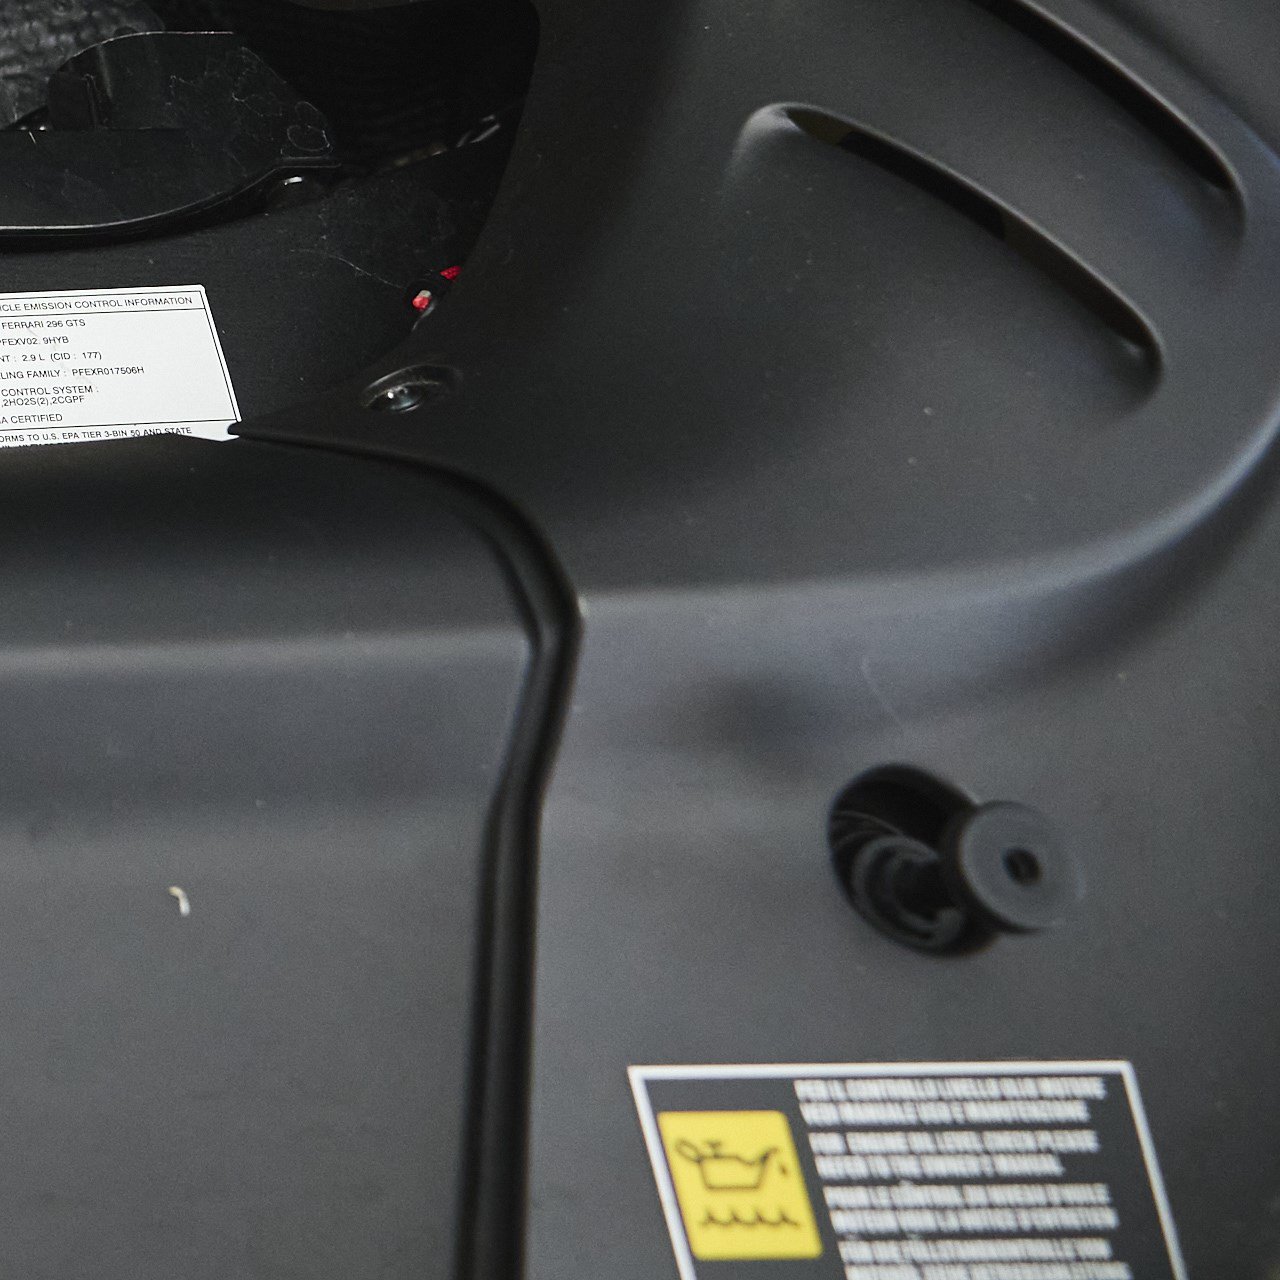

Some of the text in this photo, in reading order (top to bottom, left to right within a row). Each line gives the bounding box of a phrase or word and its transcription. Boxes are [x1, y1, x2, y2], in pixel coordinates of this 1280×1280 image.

[24, 301, 72, 311] EMISSION
[74, 300, 123, 309] CONTROL
[124, 296, 193, 306] INFORMATION
[2, 320, 44, 330] FERRARI
[46, 320, 64, 328] 296
[66, 319, 86, 328] GTS
[21, 354, 37, 362] 2.9
[82, 351, 102, 360] 177)
[1, 387, 51, 396] CONTROL
[10, 413, 63, 424] CERTIFIED
[42, 432, 60, 440] U.S.
[62, 432, 80, 440] EPA
[81, 430, 102, 438] TIER
[104, 429, 128, 438] 3-BIN
[130, 429, 141, 437] 50
[144, 428, 162, 436] AND
[164, 427, 192, 435] STATE
